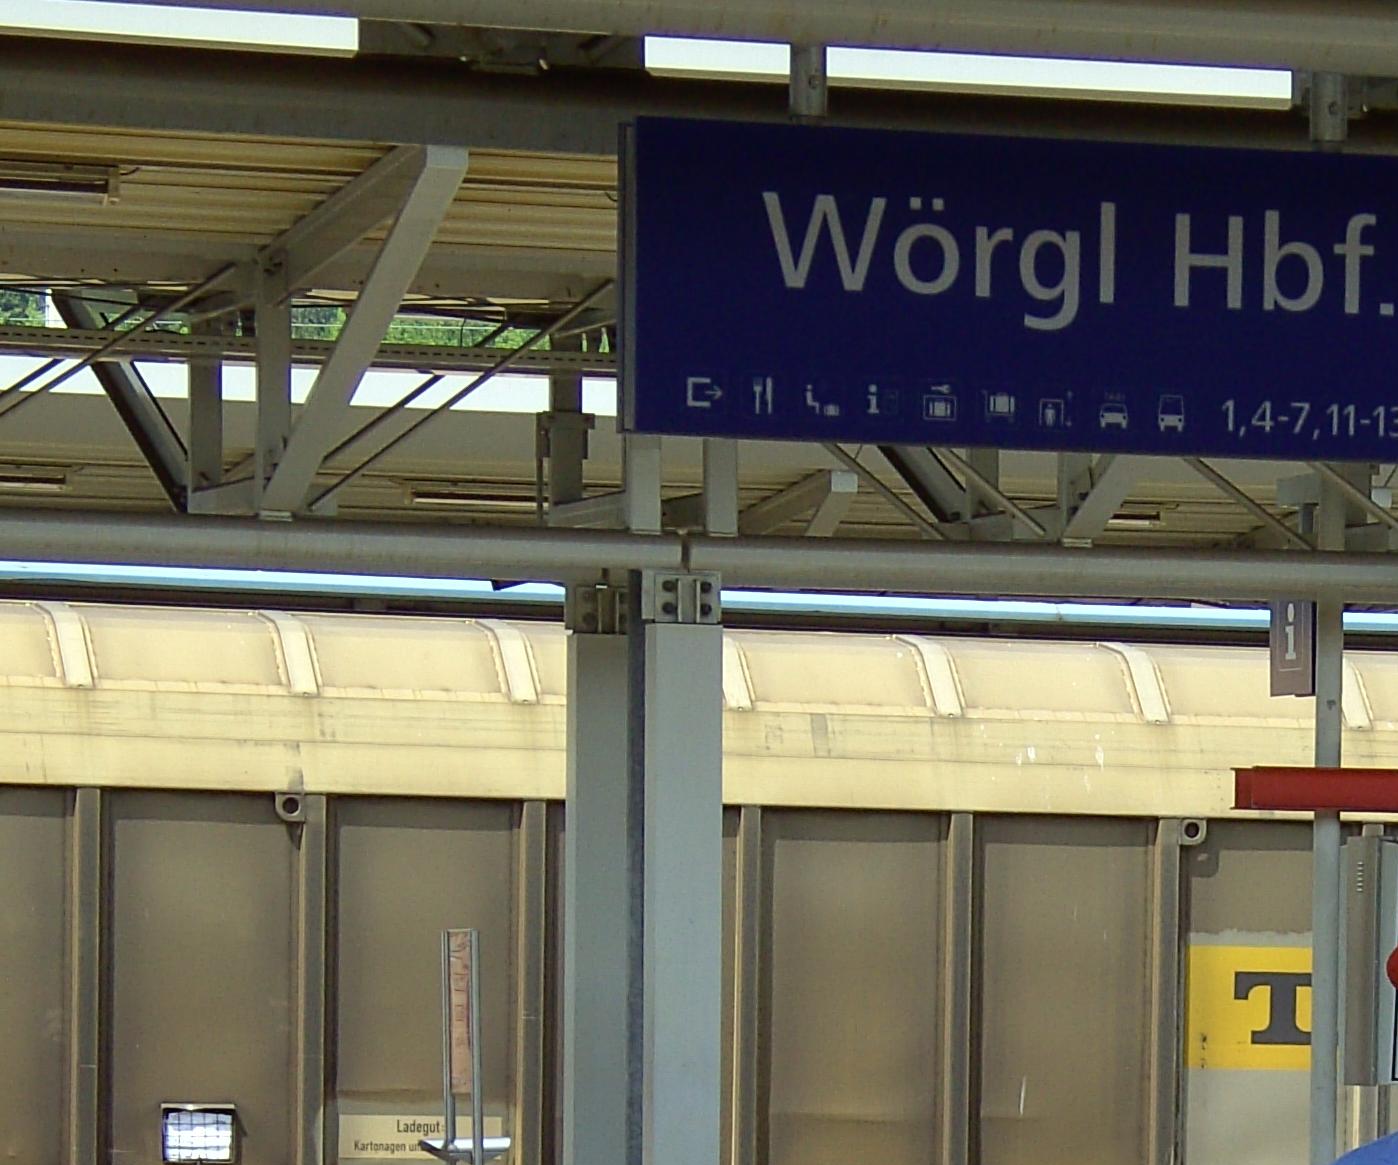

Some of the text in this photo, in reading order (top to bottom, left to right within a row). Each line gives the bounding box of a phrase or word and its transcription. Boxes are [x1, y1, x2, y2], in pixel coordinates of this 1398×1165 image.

[762, 192, 1395, 331] Wörgl Hbf.
[354, 1139, 407, 1155] Kartonagen
